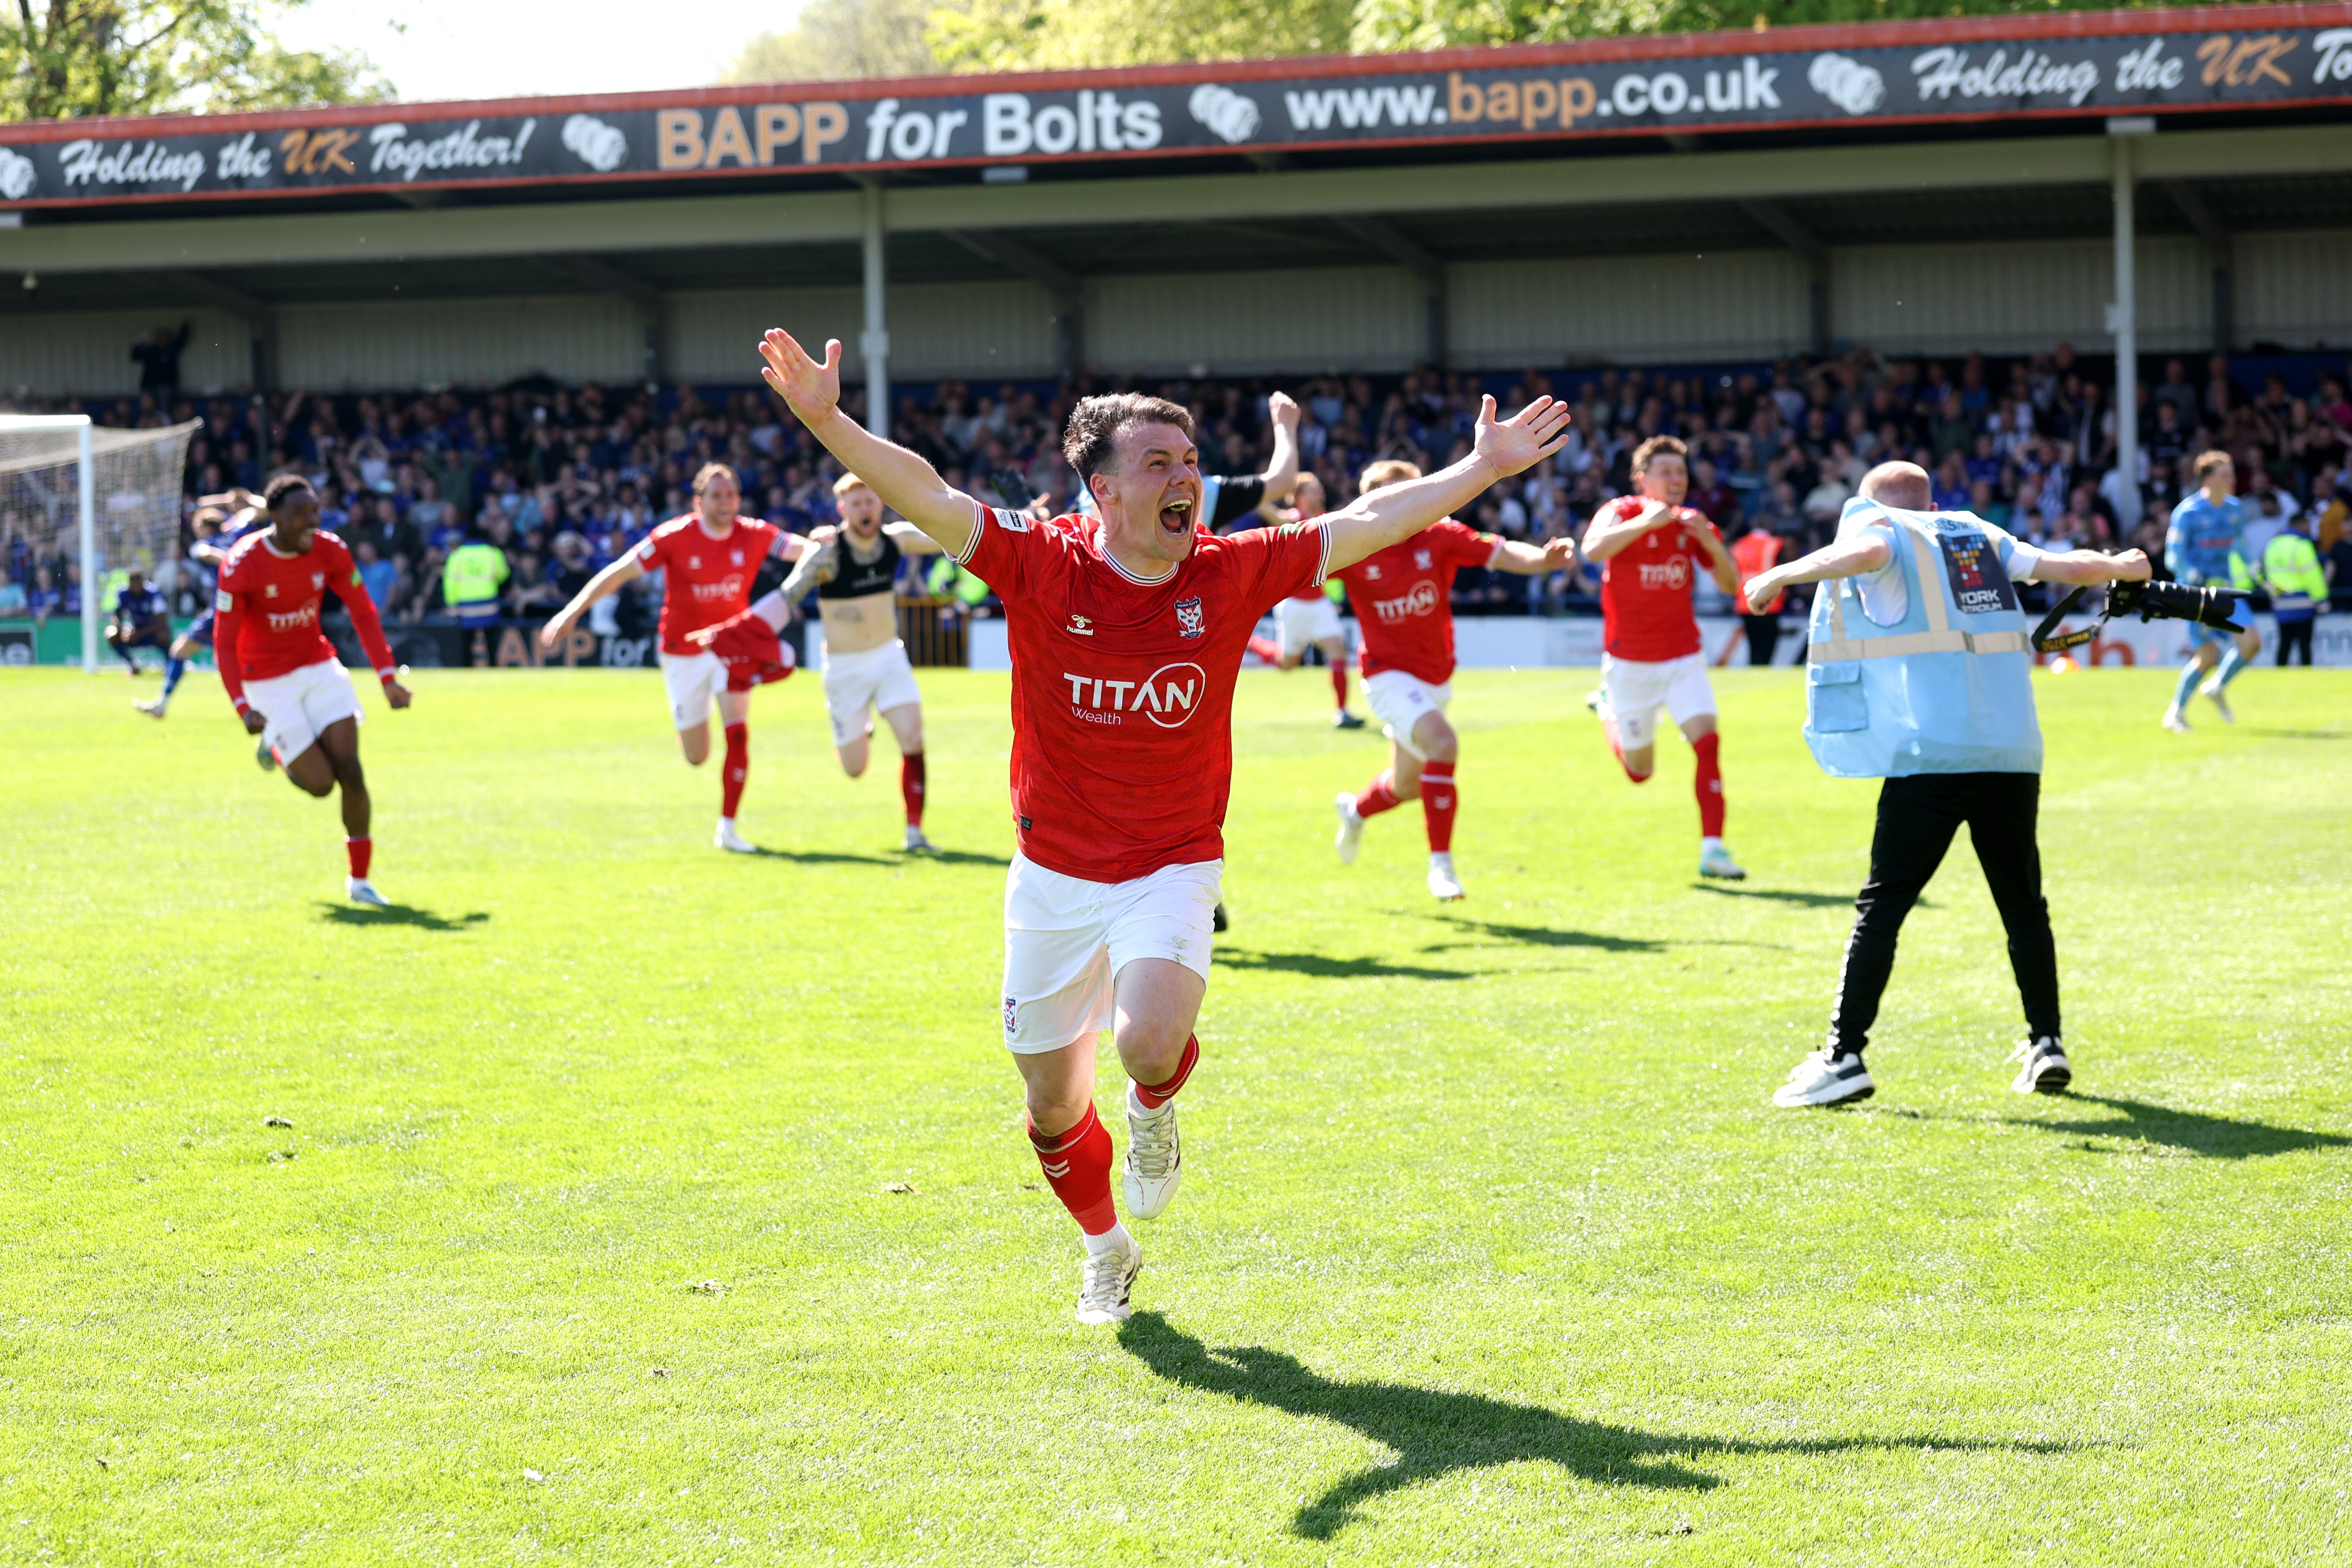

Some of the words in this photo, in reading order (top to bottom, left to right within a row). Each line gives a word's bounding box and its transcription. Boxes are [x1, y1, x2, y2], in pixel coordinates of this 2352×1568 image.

[1910, 47, 2100, 107] Holding
[2114, 37, 2185, 92] the
[2195, 35, 2301, 87] UK
[1284, 55, 1781, 130] www.bapp.co.uk
[657, 102, 850, 171] BAPP
[865, 98, 968, 162] for
[983, 89, 1163, 157] Bolts
[58, 138, 207, 192] Holding
[218, 130, 273, 179] the
[280, 128, 362, 176] UK
[369, 117, 537, 181] Together!
[1373, 587, 1435, 618] TITAN
[1958, 589, 2000, 604] YORK
[1961, 602, 2003, 613] STADIUM
[267, 607, 316, 628] TITAN
[1066, 624, 1094, 636] hummel
[1063, 672, 1195, 712] TITAN
[1071, 706, 1121, 725] Wealth
